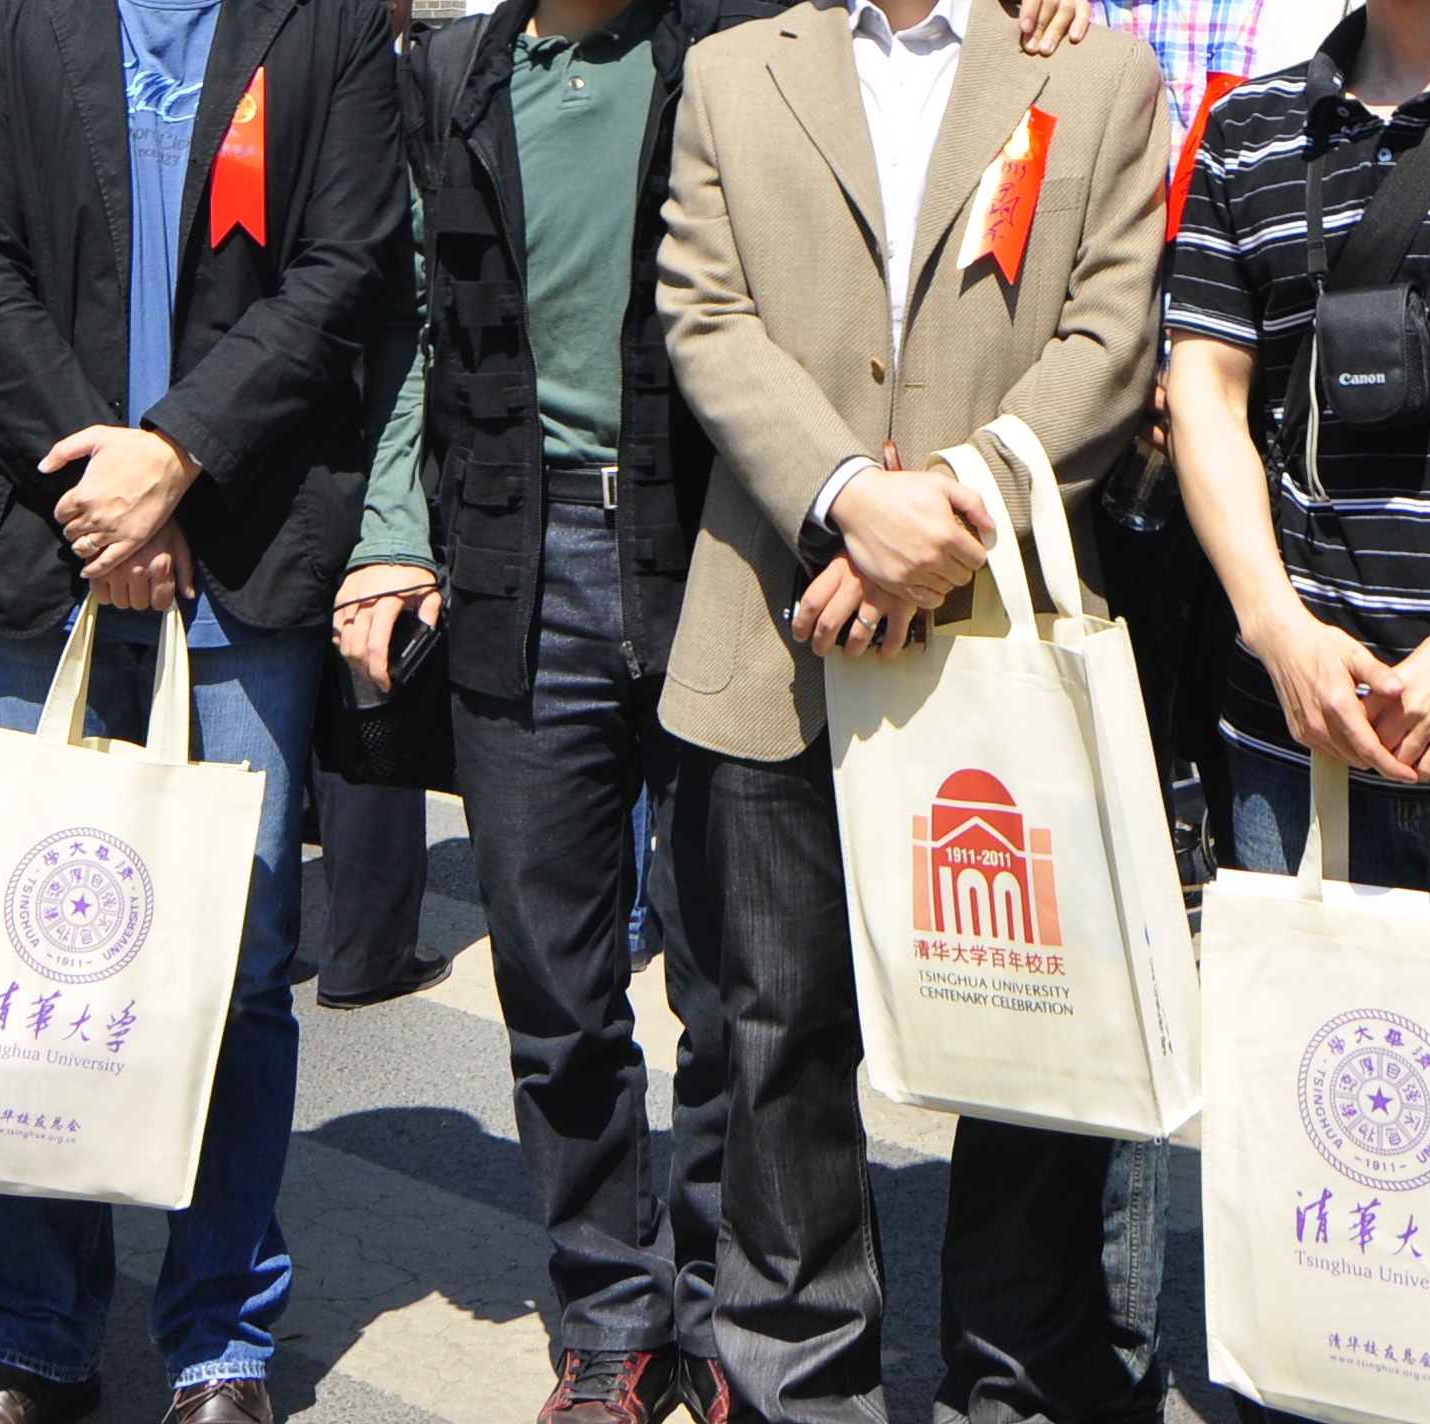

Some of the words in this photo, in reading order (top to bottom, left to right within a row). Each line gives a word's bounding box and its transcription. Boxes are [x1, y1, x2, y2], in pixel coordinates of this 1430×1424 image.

[1339, 371, 1385, 387] Canon
[945, 846, 1012, 869] 1911-2011
[19, 877, 41, 949] TSINGHUA
[102, 895, 140, 961] UNIVERSITY
[913, 938, 1066, 976] 清华大学百年校庆
[918, 969, 988, 990] TSINGHUA
[992, 977, 1070, 1000] UNIVERSITY
[919, 984, 989, 1007] CENTENARY
[991, 994, 1074, 1017] CELEBRATION
[46, 1049, 126, 1076] University
[1312, 1068, 1344, 1150] TSINGHUA
[1294, 1249, 1373, 1279] Tsinghua
